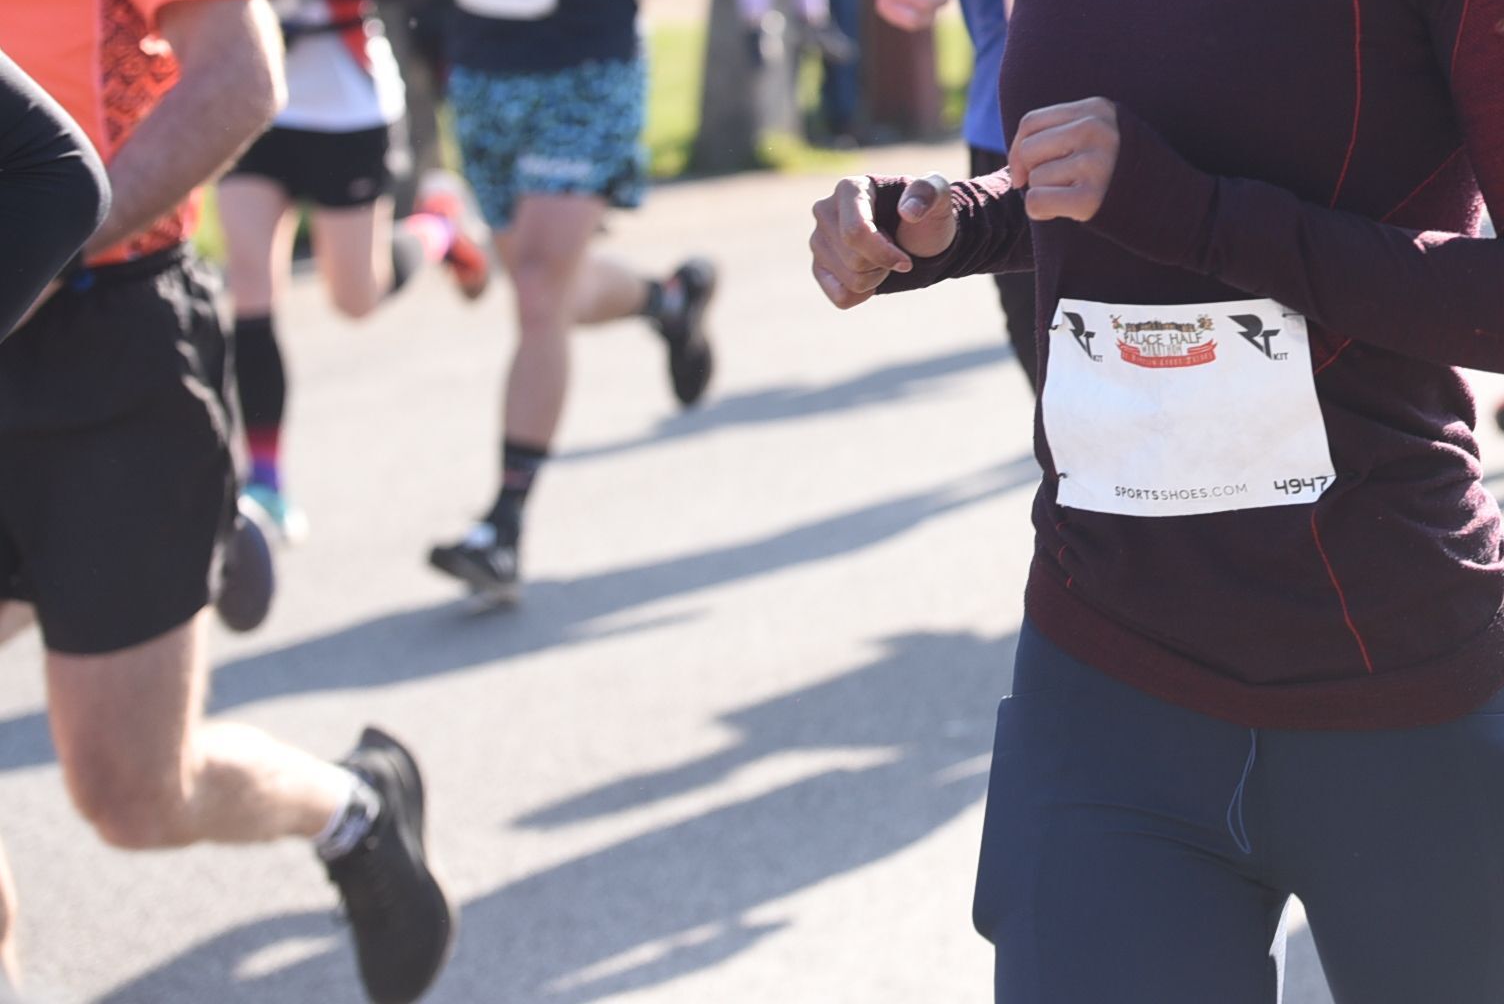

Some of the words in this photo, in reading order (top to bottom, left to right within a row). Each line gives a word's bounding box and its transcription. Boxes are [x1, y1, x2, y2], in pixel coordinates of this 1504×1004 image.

[1123, 330, 1162, 345] PALACE
[1169, 329, 1202, 344] HALF
[1273, 352, 1288, 361] KIT
[1115, 483, 1248, 501] SPORTSSHOES.COM
[1274, 476, 1328, 496] 4947
